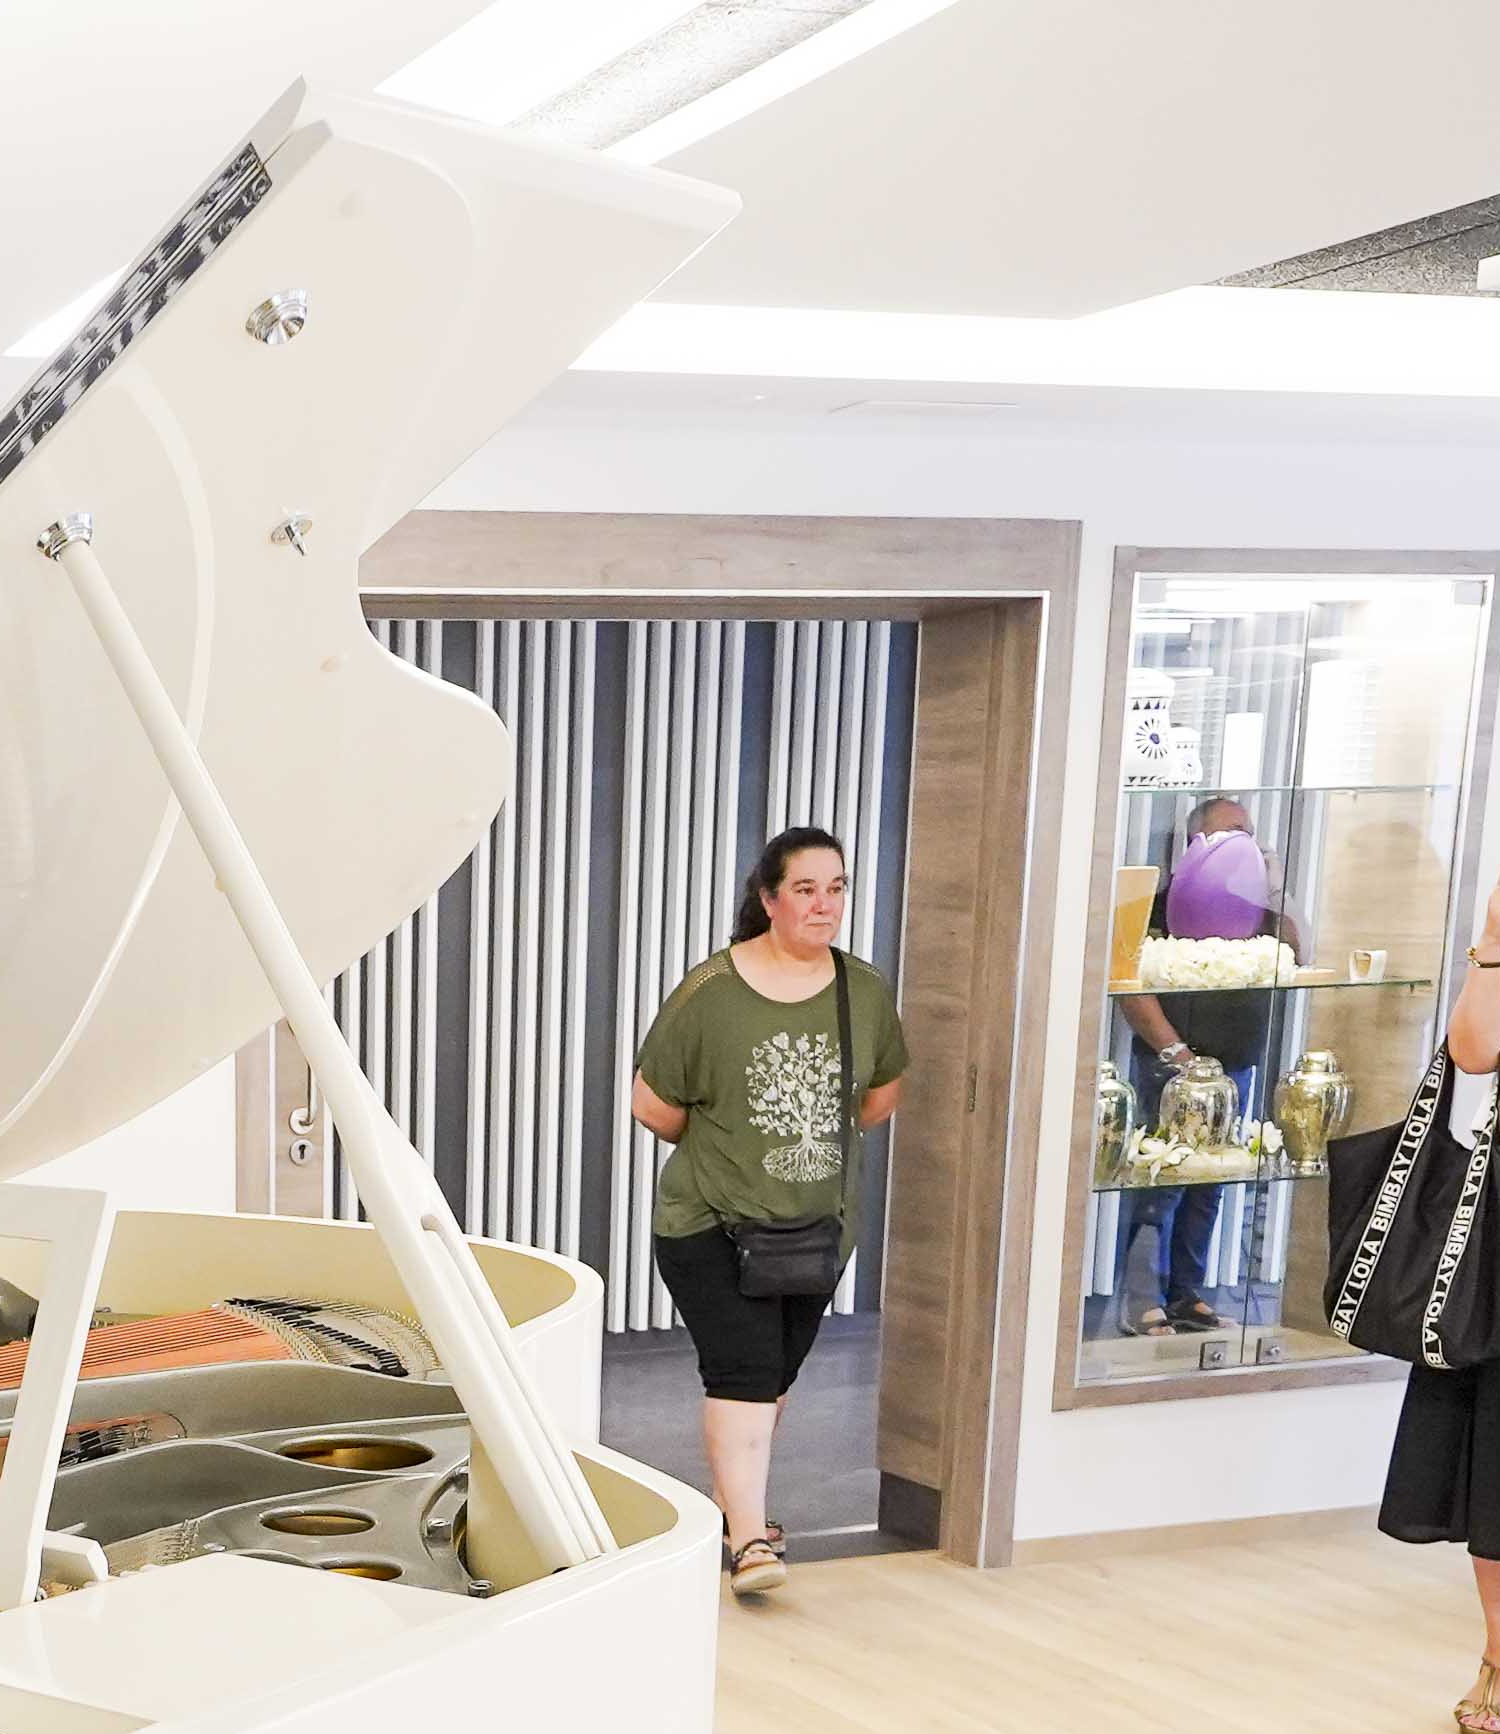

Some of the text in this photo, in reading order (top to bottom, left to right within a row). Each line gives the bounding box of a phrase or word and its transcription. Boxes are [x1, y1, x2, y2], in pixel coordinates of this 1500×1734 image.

[1347, 1240, 1381, 1290] LOLA
[1402, 1098, 1434, 1149] LOLA
[1464, 1144, 1489, 1196] LOLA
[1425, 1291, 1446, 1343] LOLA
